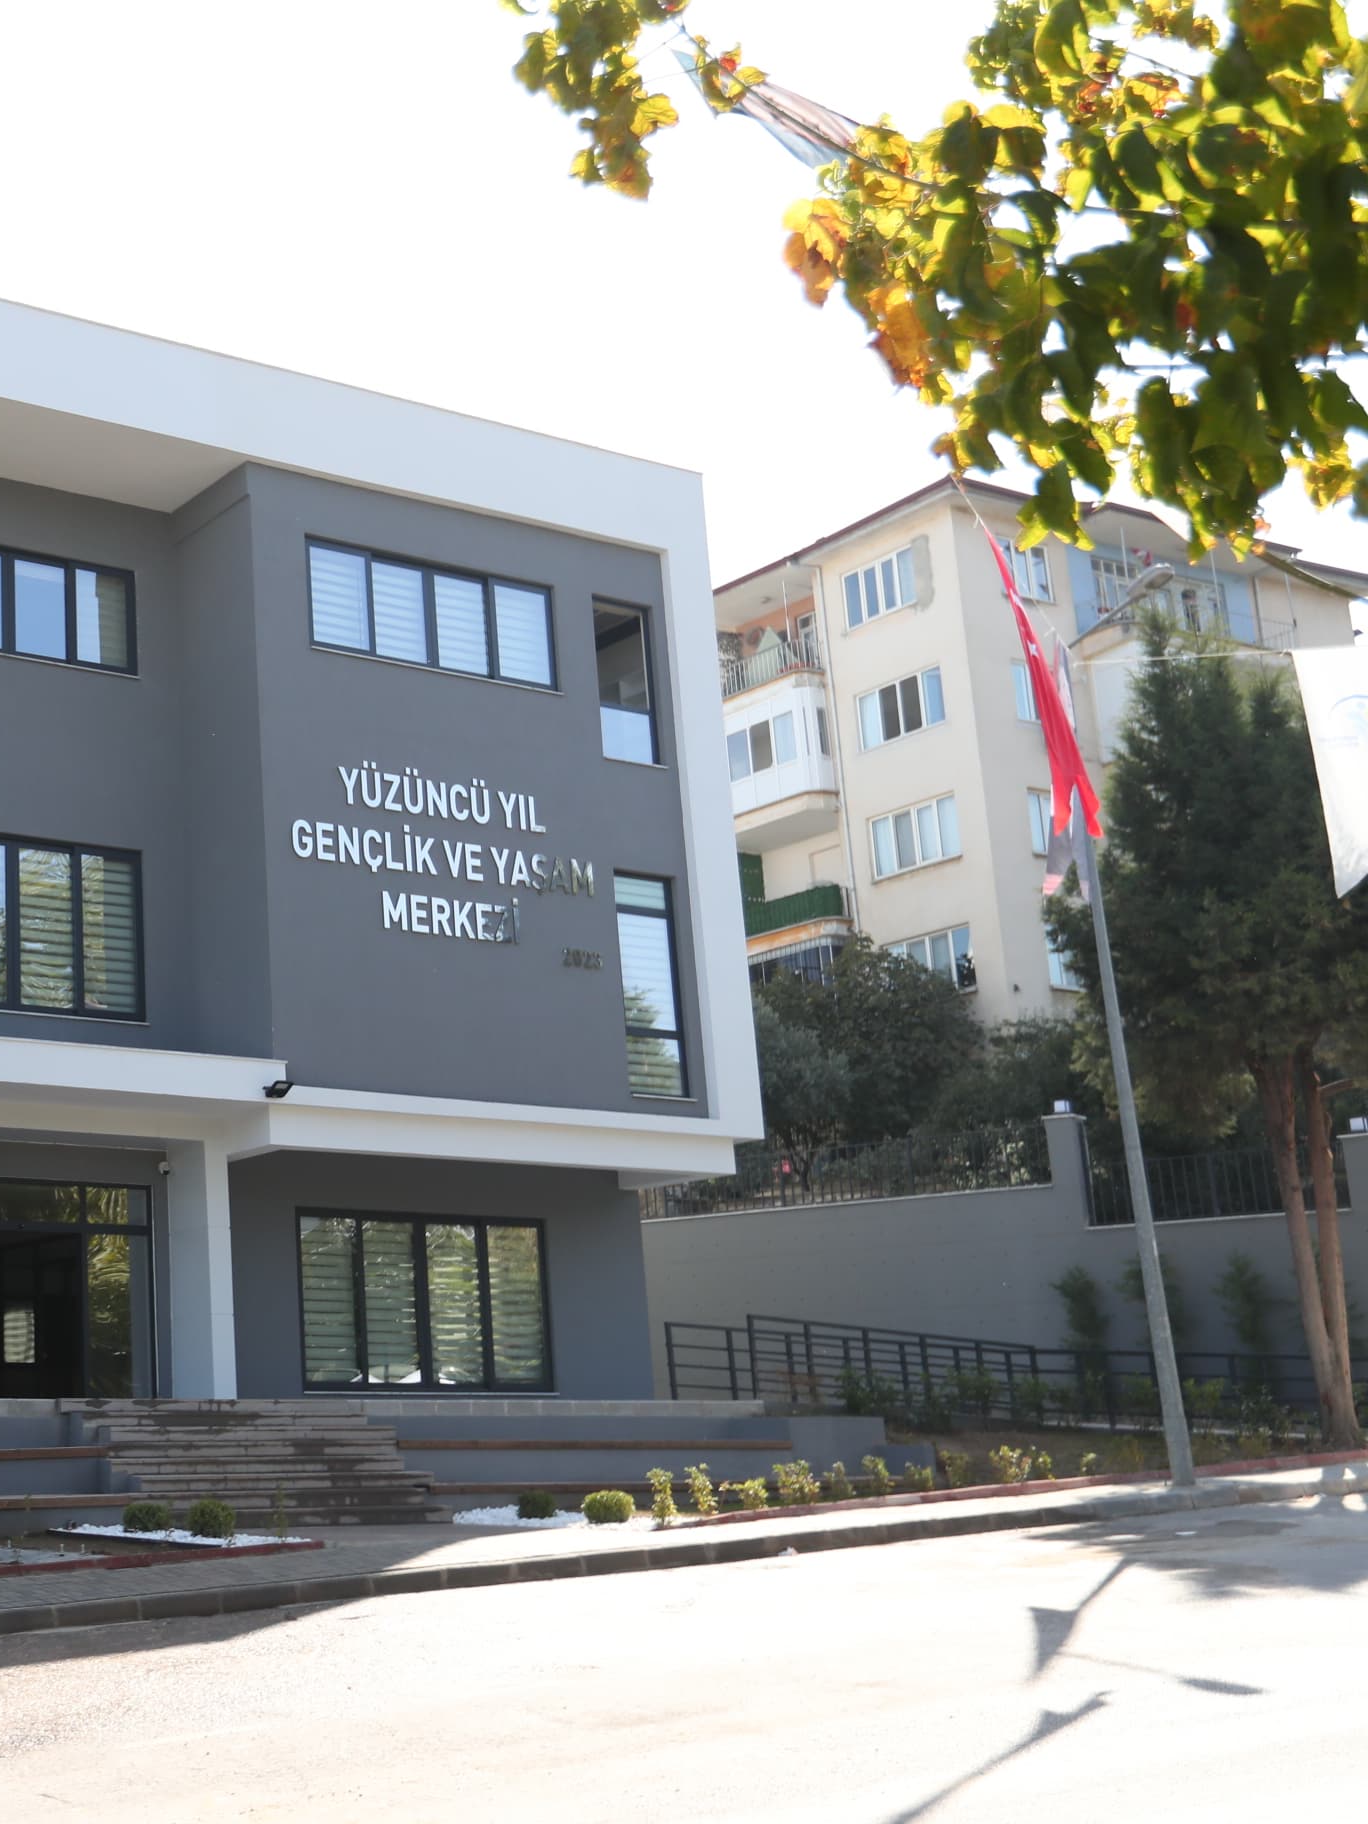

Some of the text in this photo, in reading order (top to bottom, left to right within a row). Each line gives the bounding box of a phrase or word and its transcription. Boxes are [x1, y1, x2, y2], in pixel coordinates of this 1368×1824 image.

[338, 760, 547, 833] YÜZÜNCÜ YIL
[291, 819, 595, 897] GENÇLİK VE YAŞAM
[382, 890, 521, 945] MERKEZİ
